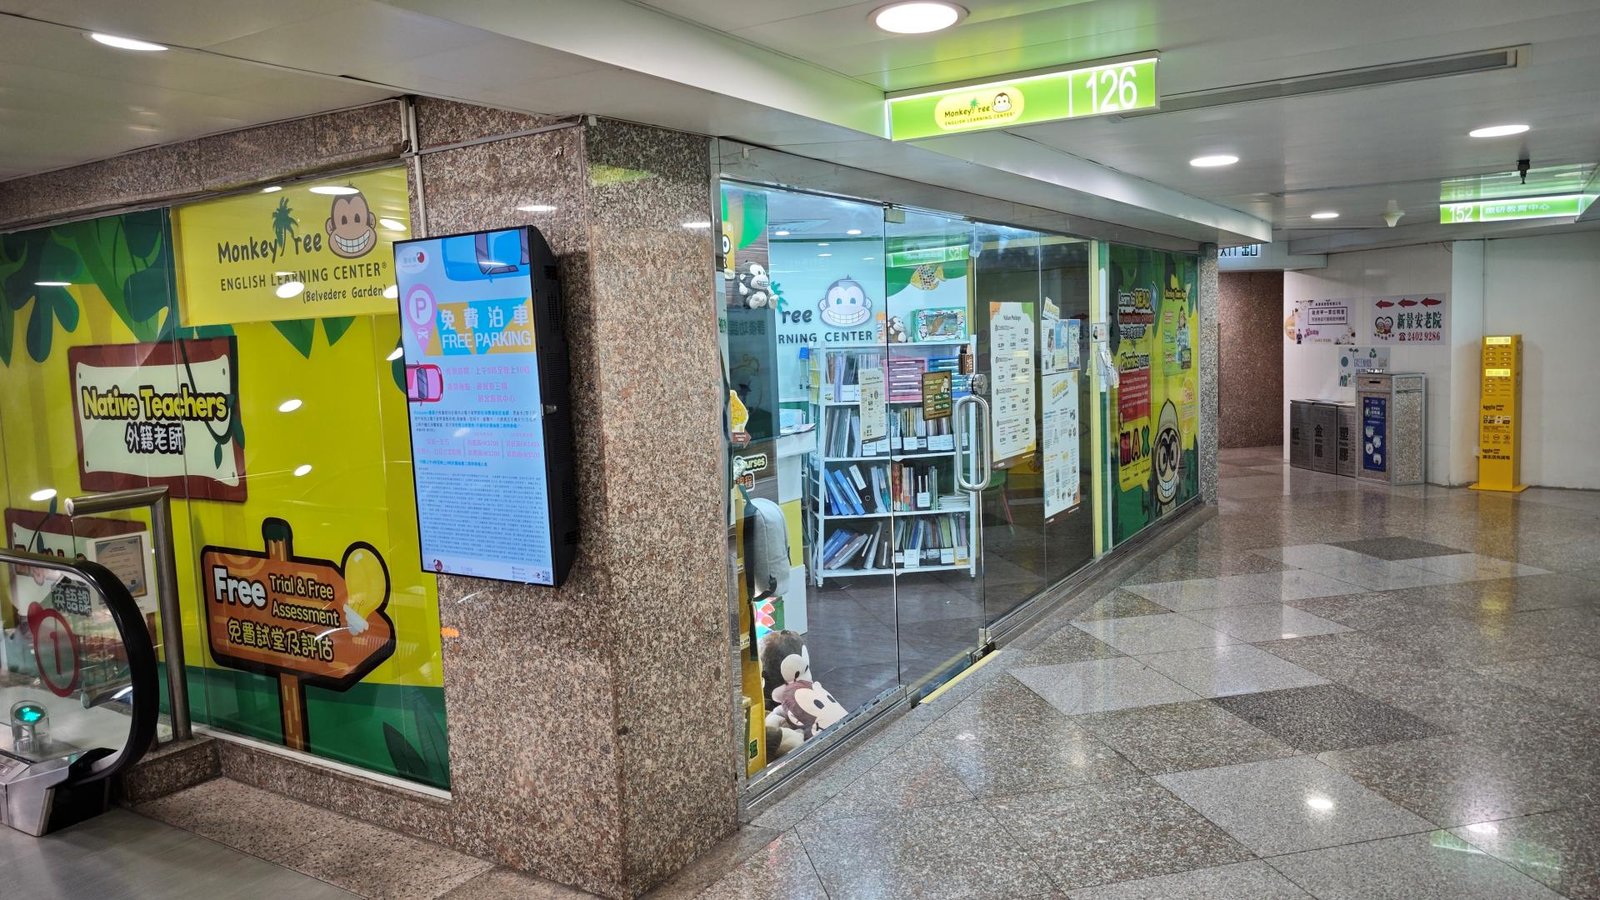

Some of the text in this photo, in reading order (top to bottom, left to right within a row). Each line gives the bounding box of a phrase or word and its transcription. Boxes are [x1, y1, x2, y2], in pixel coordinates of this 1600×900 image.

[1086, 66, 1137, 112] 126
[944, 108, 971, 118] Monkey
[1449, 205, 1473, 221] 152
[217, 238, 277, 264] Monkey
[220, 274, 266, 292] ENGLISH
[270, 267, 328, 288] LEARNING
[302, 287, 347, 304] (Belvedere
[415, 298, 427, 319] P
[441, 304, 529, 331] 免費泊車
[442, 330, 532, 349] FREE PARKING
[824, 330, 873, 342] CENTER
[1408, 332, 1423, 341] 2402
[83, 385, 228, 420] Native Teachers
[126, 423, 184, 453] 外籍老師
[213, 566, 267, 608] Free
[269, 574, 334, 600] Trial & Free
[272, 600, 340, 626] Assessment
[228, 619, 334, 661] 免費試堂及評估
